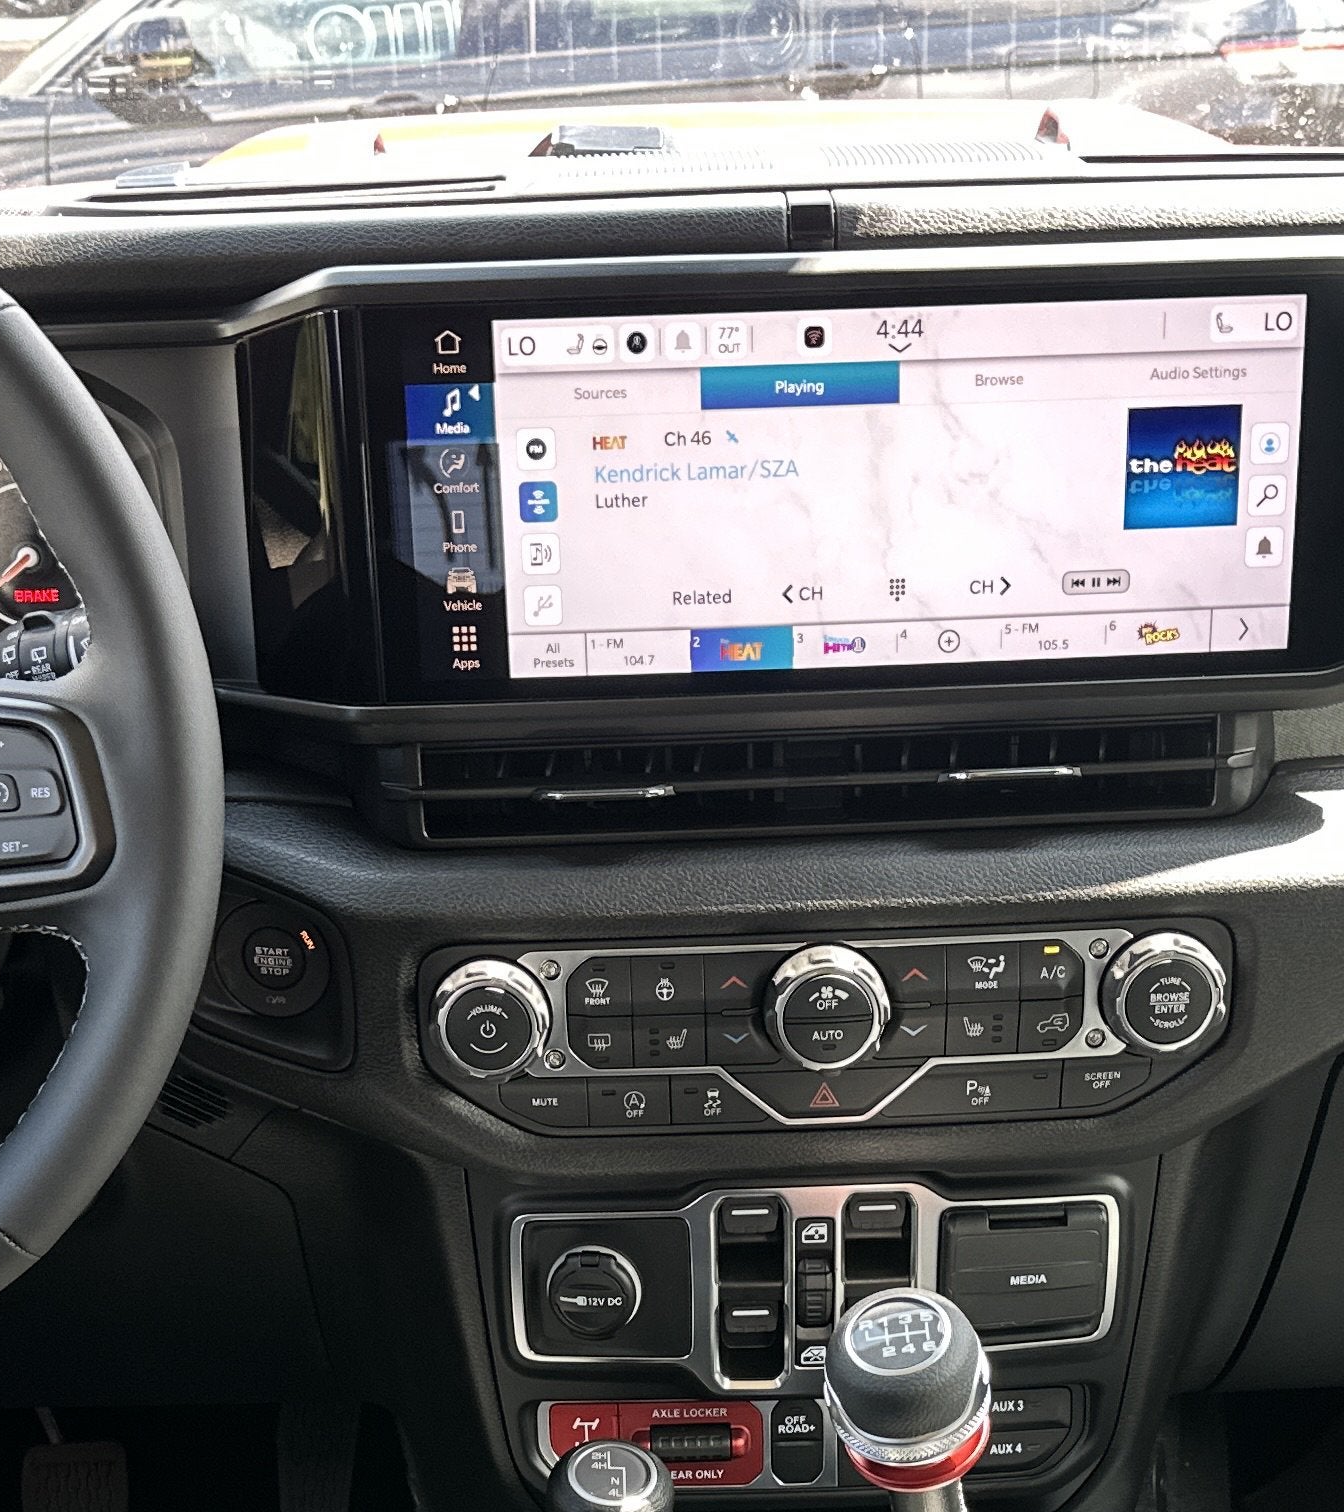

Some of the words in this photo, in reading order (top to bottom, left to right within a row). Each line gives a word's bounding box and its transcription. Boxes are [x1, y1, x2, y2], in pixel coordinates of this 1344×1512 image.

[1264, 312, 1293, 332] LO
[876, 318, 925, 340] 4:44
[507, 336, 537, 356] LO
[718, 342, 741, 354] OUT
[433, 362, 467, 375] Home
[1150, 366, 1191, 382] Audio
[1192, 364, 1248, 382] Settings
[975, 373, 1024, 388] Browse
[573, 386, 627, 400] Sources
[775, 379, 825, 396] Playing
[435, 422, 471, 436] Media
[592, 434, 628, 451] HEAT
[664, 430, 688, 447] Ch
[690, 430, 712, 447] 46
[594, 463, 684, 484] Kendrick
[687, 459, 800, 482] Lamar/SZA
[1128, 458, 1173, 474] the
[433, 481, 480, 495] Comfort
[595, 492, 649, 510] Luther
[442, 540, 478, 554] Phone
[970, 579, 994, 594] CH
[14, 588, 60, 604] BRAKE
[672, 588, 733, 606] Related
[798, 587, 824, 603] CH
[443, 599, 483, 612] Vehicle
[1022, 622, 1039, 634] FM
[1109, 620, 1117, 632] 6
[796, 633, 804, 644] 3
[900, 629, 908, 640] 4
[606, 637, 624, 649] FM
[692, 636, 701, 648] 2
[1038, 638, 1069, 651] 105.5
[545, 642, 561, 655] All
[720, 641, 763, 661] HEAT
[452, 657, 481, 671] Apps
[533, 656, 575, 669] Presets
[623, 654, 655, 667] 104.7
[30, 787, 51, 799] RES
[255, 946, 289, 957] START
[253, 956, 293, 967] ENGINE
[260, 966, 290, 976] STOP
[1039, 965, 1067, 980] A/C
[974, 980, 999, 990] MODE
[1159, 976, 1182, 987] TUNE
[584, 996, 611, 1006] FRONT
[1150, 992, 1190, 1003] BROWSE
[470, 1004, 504, 1017] VOLUME
[816, 999, 839, 1011] OFF
[1154, 1003, 1186, 1014] ENTER
[1153, 1017, 1185, 1030] SCROLL
[811, 1029, 844, 1041] AUTO
[1084, 1071, 1121, 1081] SCREEN
[1092, 1080, 1111, 1089] OFF
[532, 1097, 559, 1107] MUTE
[971, 1096, 989, 1106] OFF
[625, 1108, 644, 1118] OFF
[703, 1106, 722, 1117] OFF
[1009, 1273, 1048, 1287] MEDIA
[587, 1296, 605, 1307] 12V
[607, 1296, 623, 1307] DC
[901, 1343, 917, 1355] 4
[992, 1402, 1015, 1413] AUX
[1017, 1400, 1024, 1412] 3
[651, 1408, 681, 1419] AXLE
[682, 1407, 728, 1418] LOCKER
[784, 1415, 807, 1426] OFF
[778, 1424, 816, 1434] ROAD+
[990, 1444, 1013, 1456] AUX
[1014, 1443, 1023, 1454] 4
[591, 1461, 608, 1471] 4H
[610, 1476, 620, 1486] N
[667, 1470, 694, 1480] EAR
[696, 1470, 725, 1480] ONLY
[608, 1488, 623, 1498] 4L
